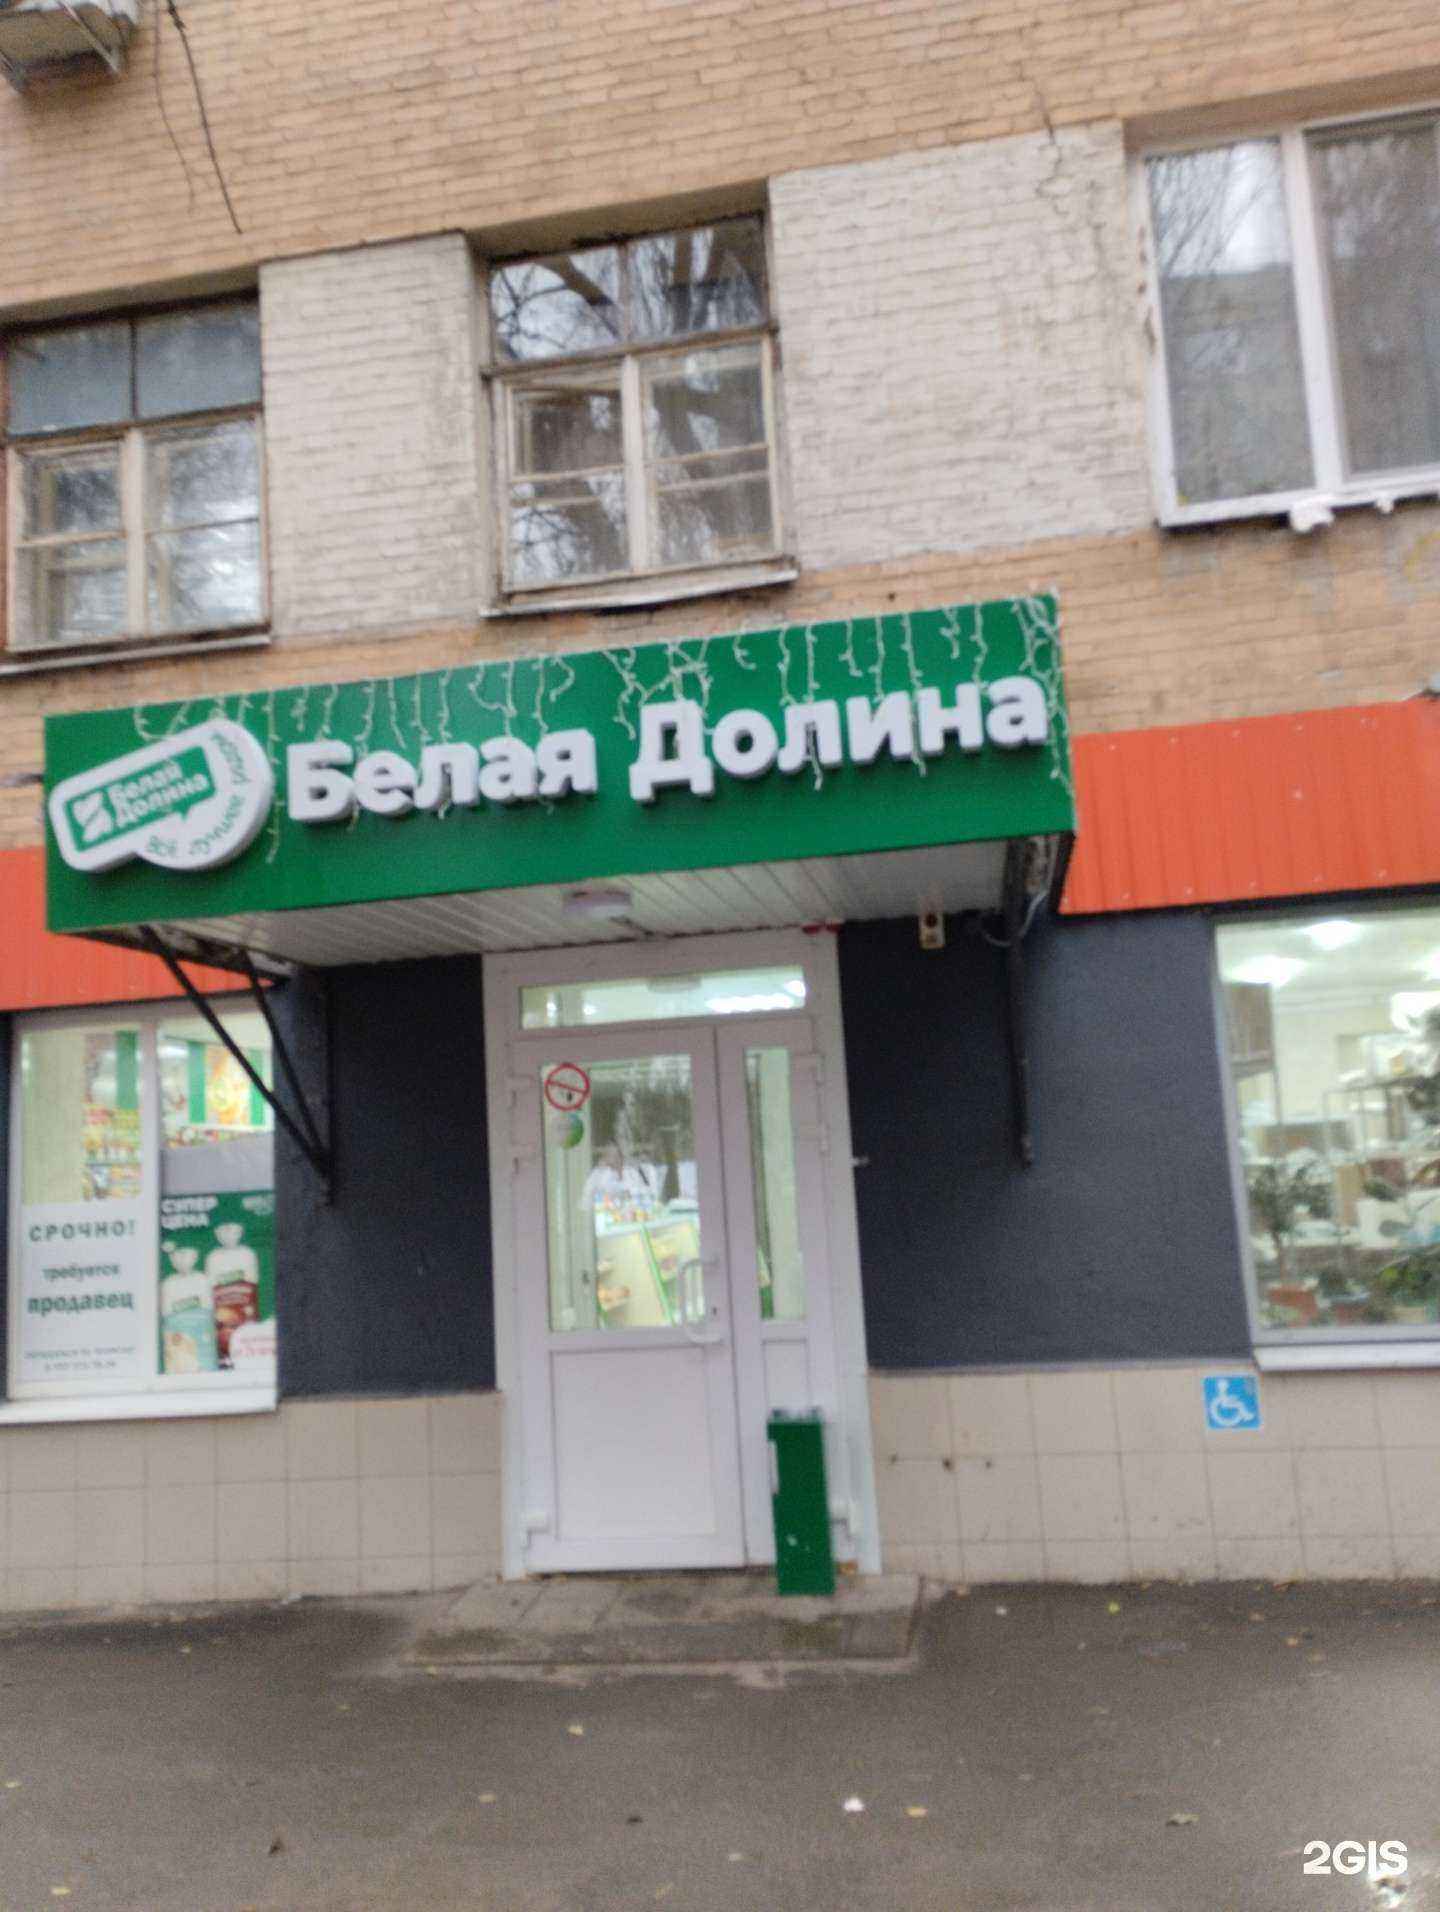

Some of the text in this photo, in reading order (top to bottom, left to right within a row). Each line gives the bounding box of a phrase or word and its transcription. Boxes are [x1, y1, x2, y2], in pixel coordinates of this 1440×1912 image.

[286, 729, 598, 822] Белая
[629, 676, 1048, 802] Долина
[29, 1220, 136, 1241] СРОЧНО!
[27, 1293, 134, 1317] продавец
